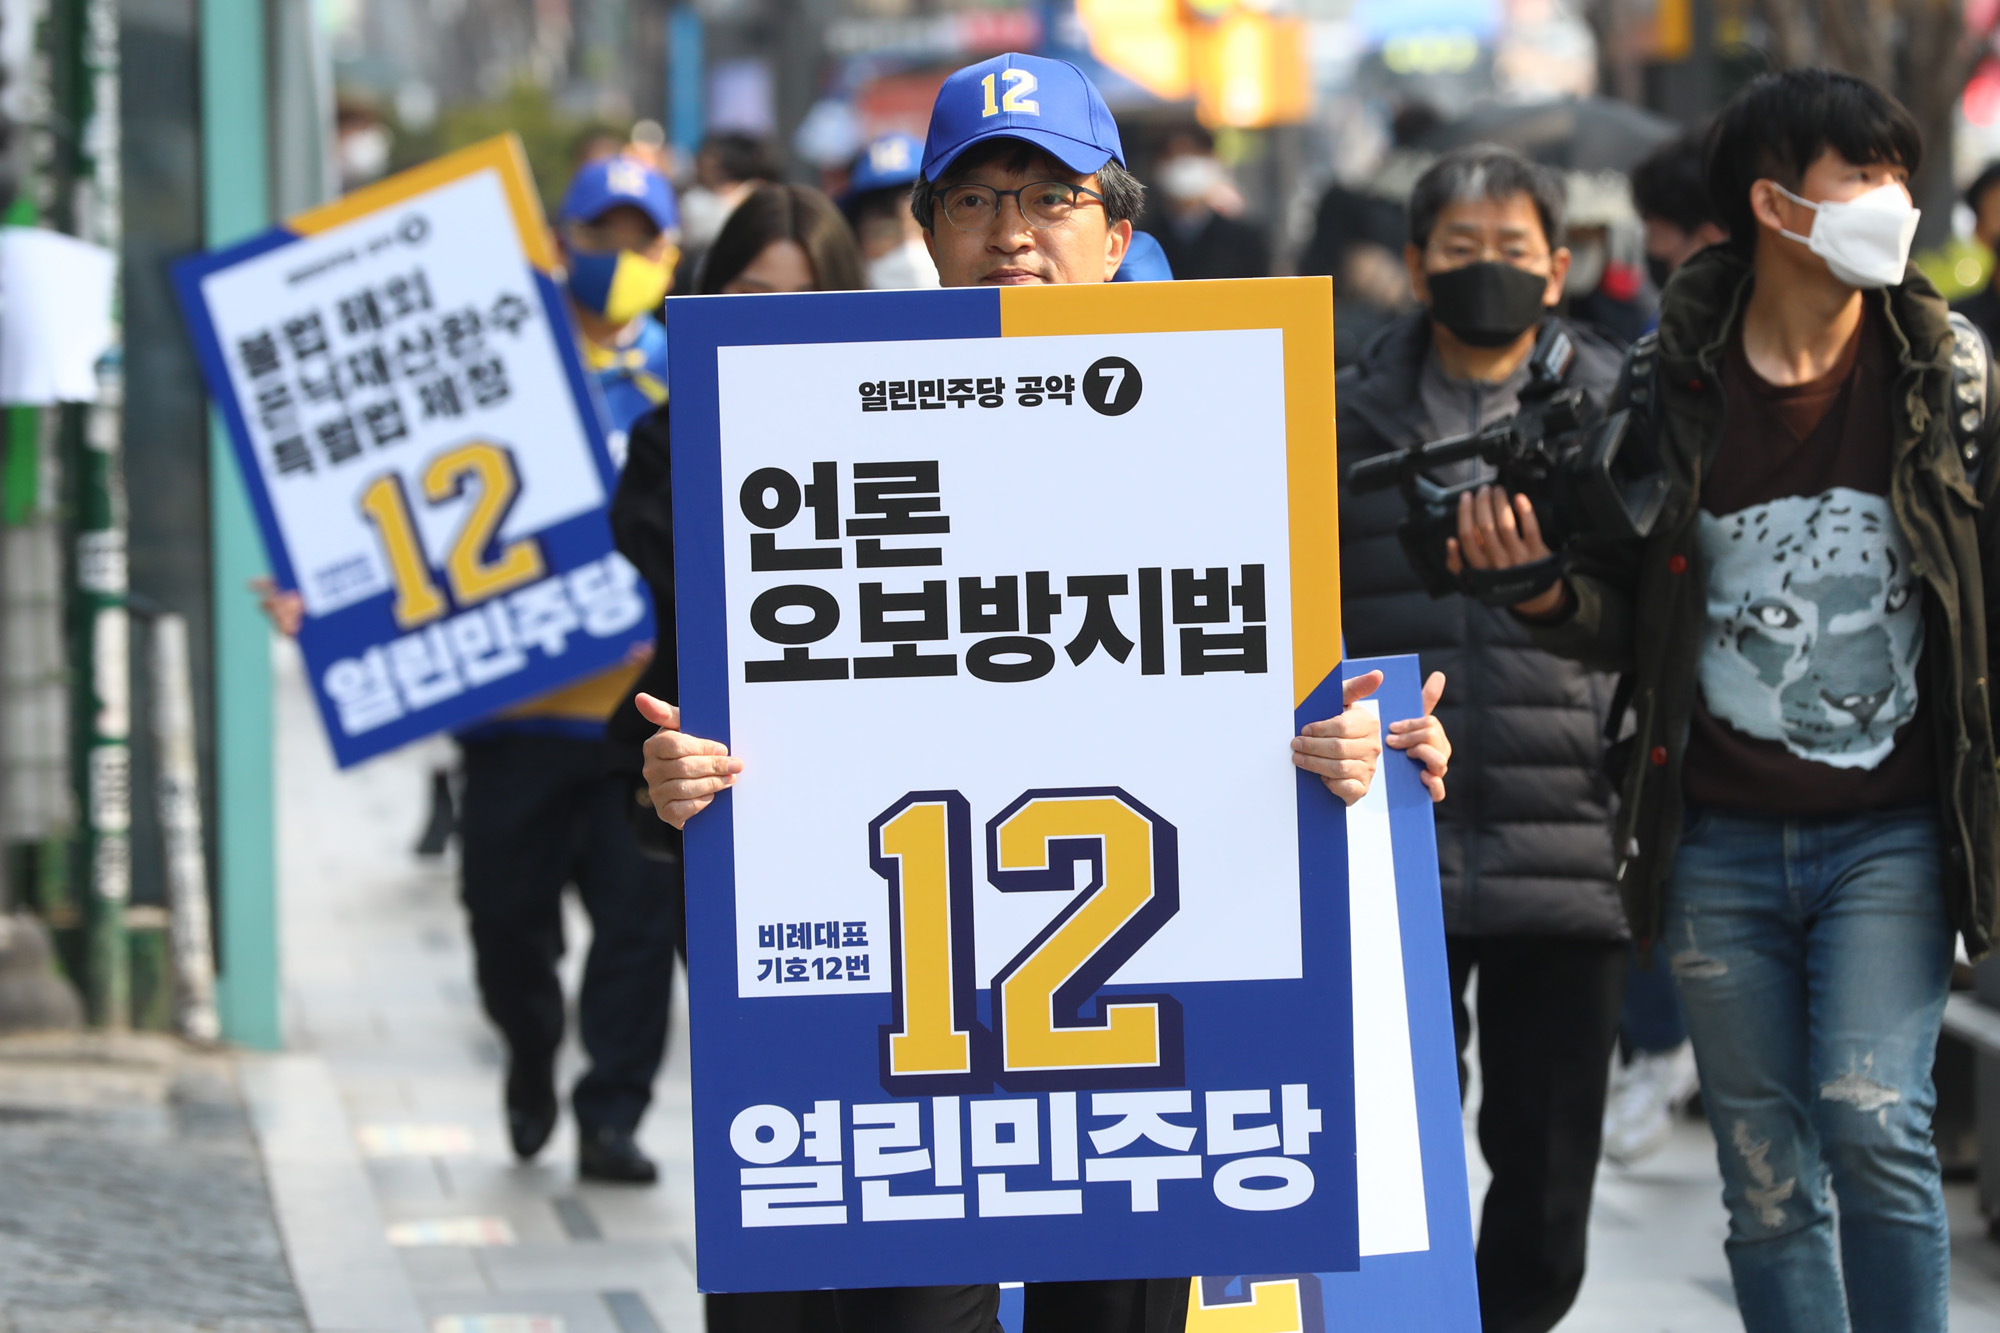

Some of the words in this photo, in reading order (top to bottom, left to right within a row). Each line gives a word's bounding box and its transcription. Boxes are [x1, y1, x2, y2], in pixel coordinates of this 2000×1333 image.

[981, 68, 1040, 117] 12
[858, 377, 1006, 413] 열린민주당
[1015, 374, 1076, 408] 공약
[1098, 367, 1126, 405] 7
[359, 440, 548, 631] 12
[739, 459, 951, 572] 언론
[322, 549, 646, 737] 열린민주당
[744, 563, 1268, 684] 오보방지법
[757, 954, 871, 984] 기호12번
[758, 921, 869, 951] 비례대표
[872, 788, 1182, 1091] 12
[729, 1083, 1322, 1229] 열린민주당
